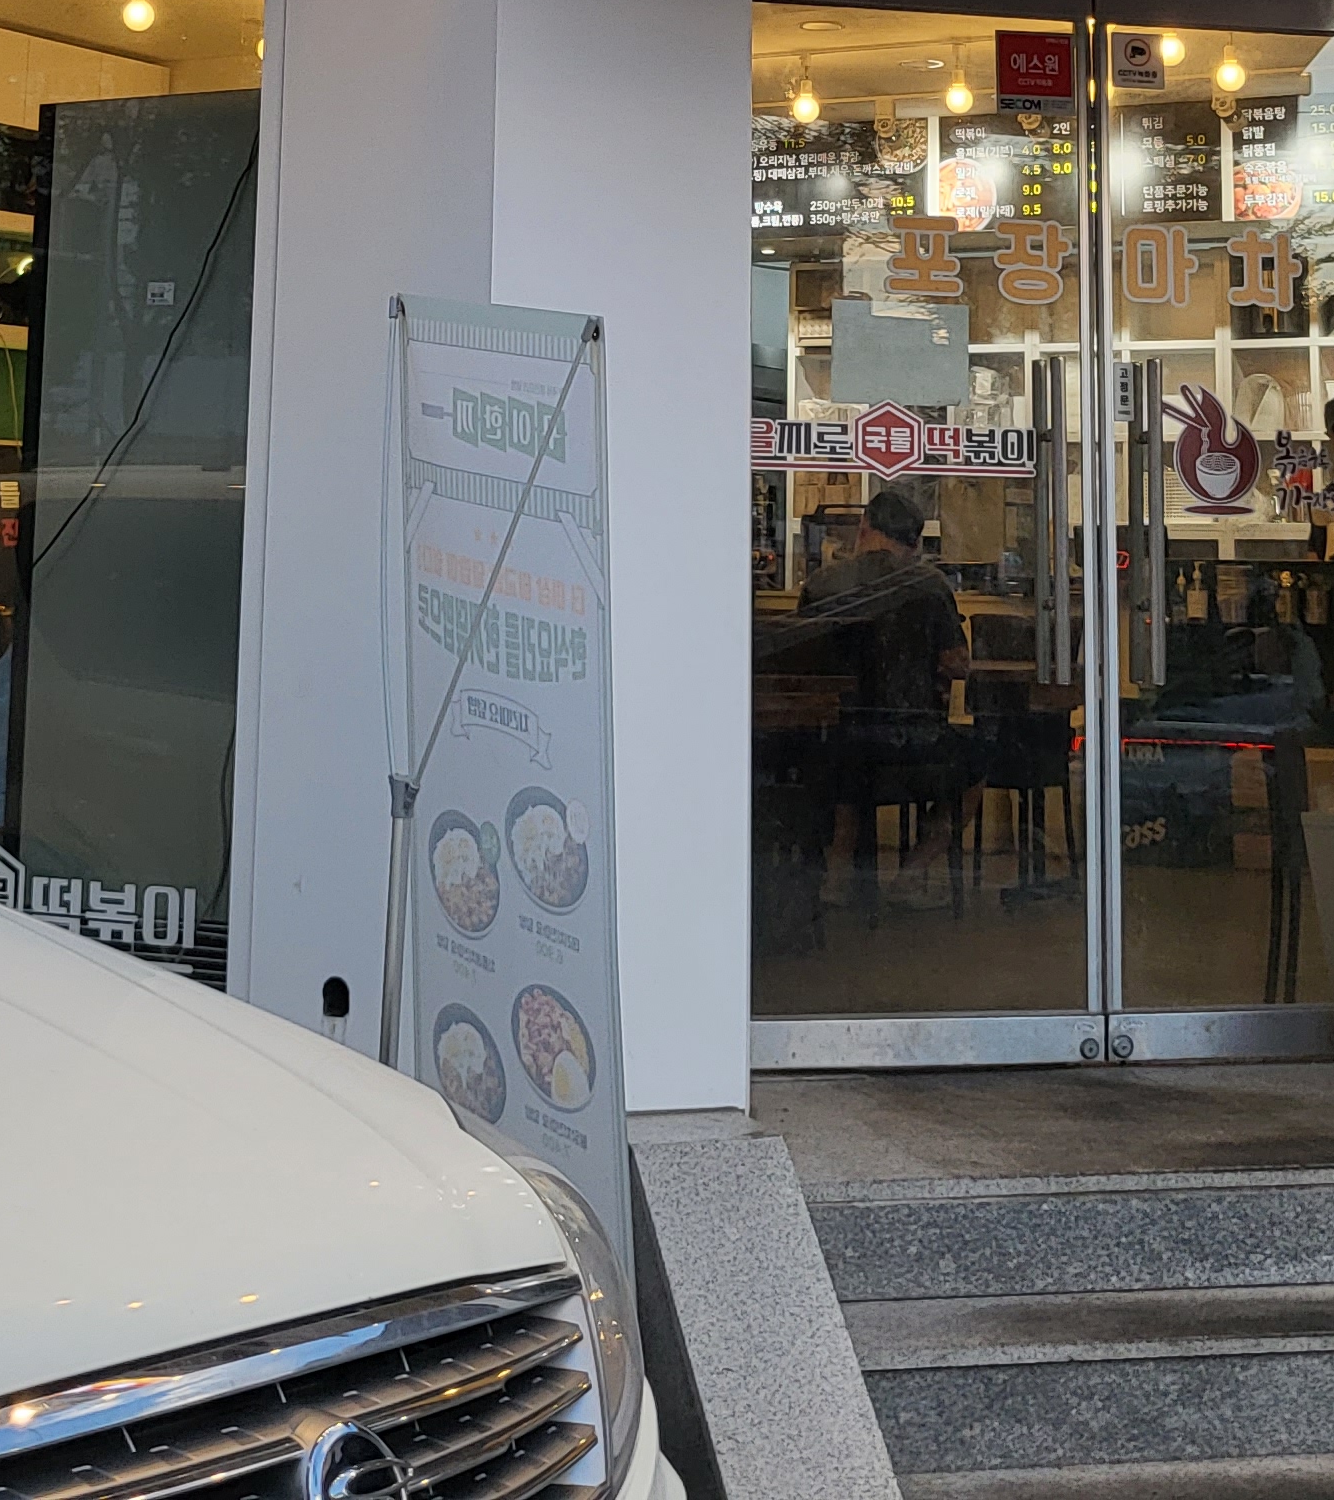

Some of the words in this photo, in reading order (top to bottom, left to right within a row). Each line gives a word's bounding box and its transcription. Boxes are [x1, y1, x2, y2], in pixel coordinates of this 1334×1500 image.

[1010, 53, 1059, 75] 에스원
[1141, 116, 1164, 130] 튀김
[1186, 134, 1206, 146] 5.0
[1022, 144, 1040, 155] 4.0
[1052, 142, 1072, 154] 8.0
[1022, 164, 1041, 175] 4.5
[1052, 162, 1072, 174] 9.0
[1022, 184, 1041, 196] 9.0
[890, 196, 915, 208] 10.5
[1142, 198, 1209, 213] 토핑추가가능
[1022, 203, 1042, 216] 9.5
[888, 215, 1304, 313] 포장마차
[865, 426, 912, 453] 국물
[925, 423, 1037, 464] 떡볶이
